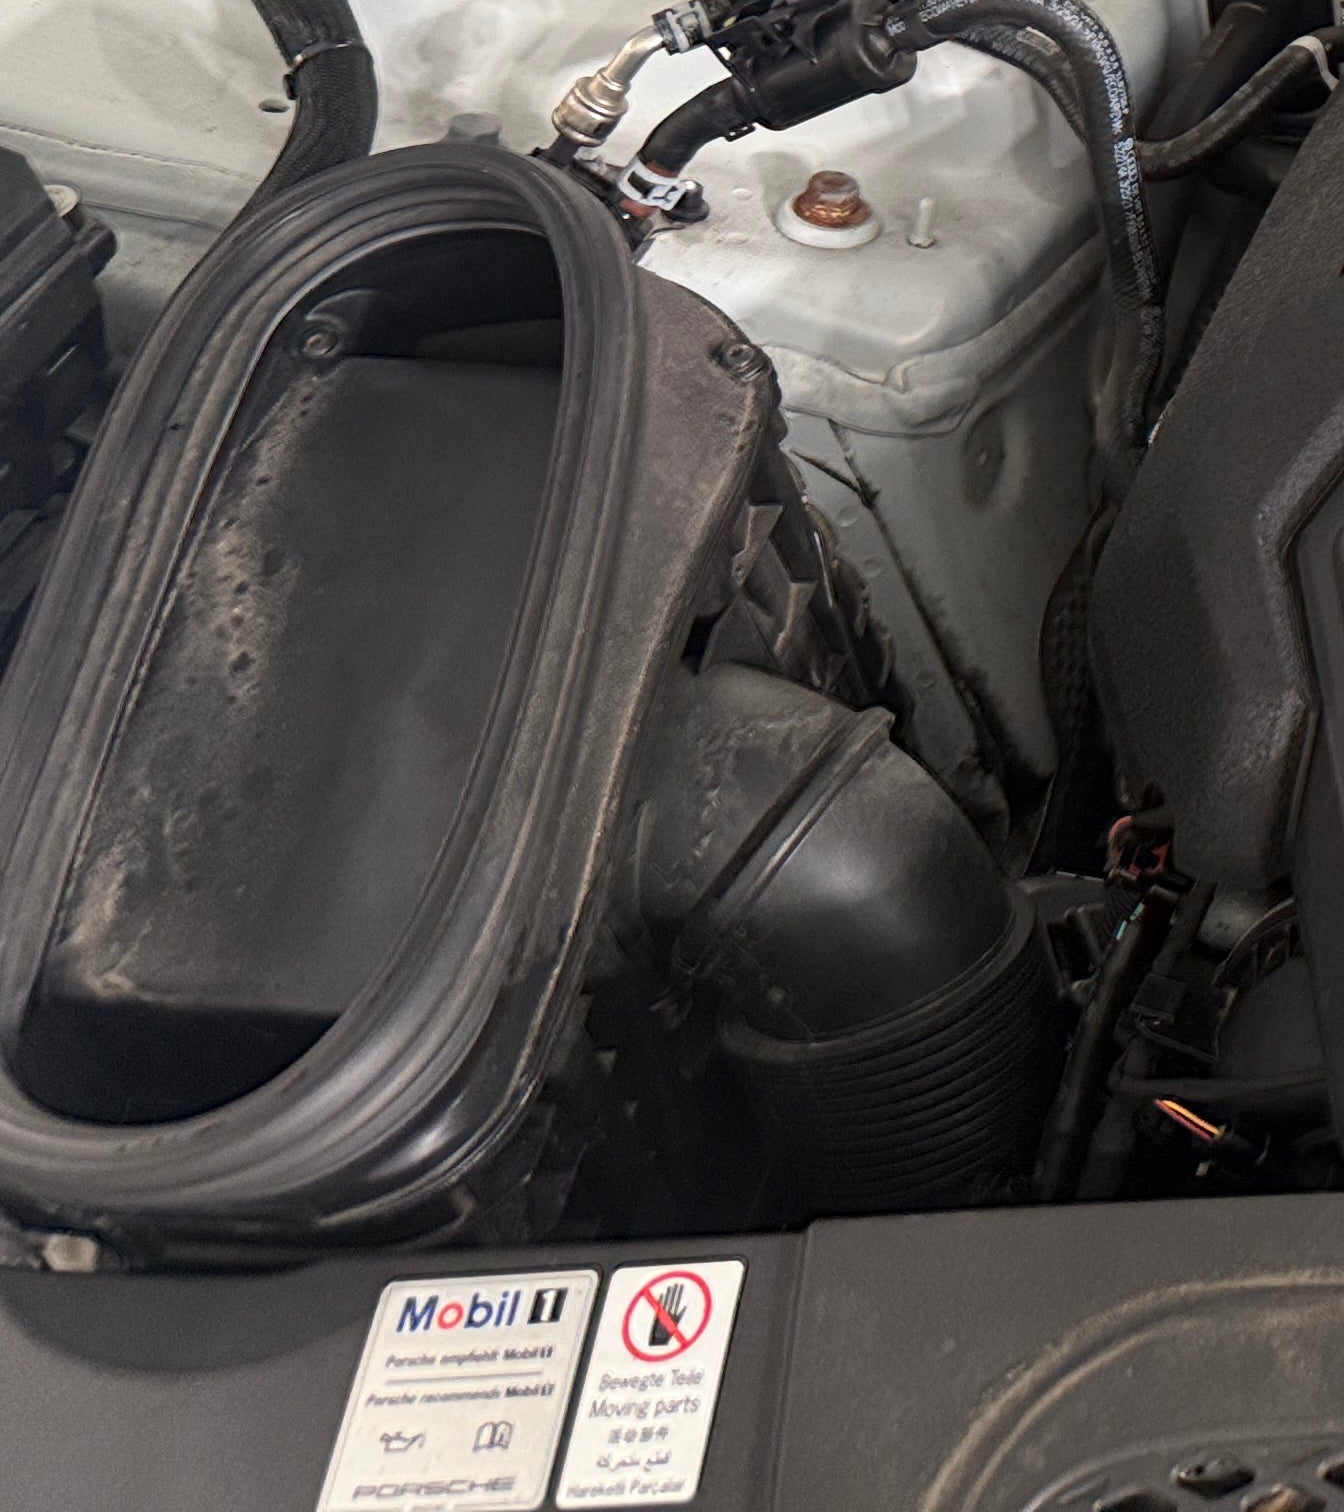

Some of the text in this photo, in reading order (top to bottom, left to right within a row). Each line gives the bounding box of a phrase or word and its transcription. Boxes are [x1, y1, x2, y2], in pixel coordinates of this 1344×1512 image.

[396, 1288, 561, 1333] Mobil 1
[599, 1367, 705, 1392] Bewegte Teile
[588, 1395, 702, 1419] Moving parts
[352, 1474, 517, 1500] PORSCHE
